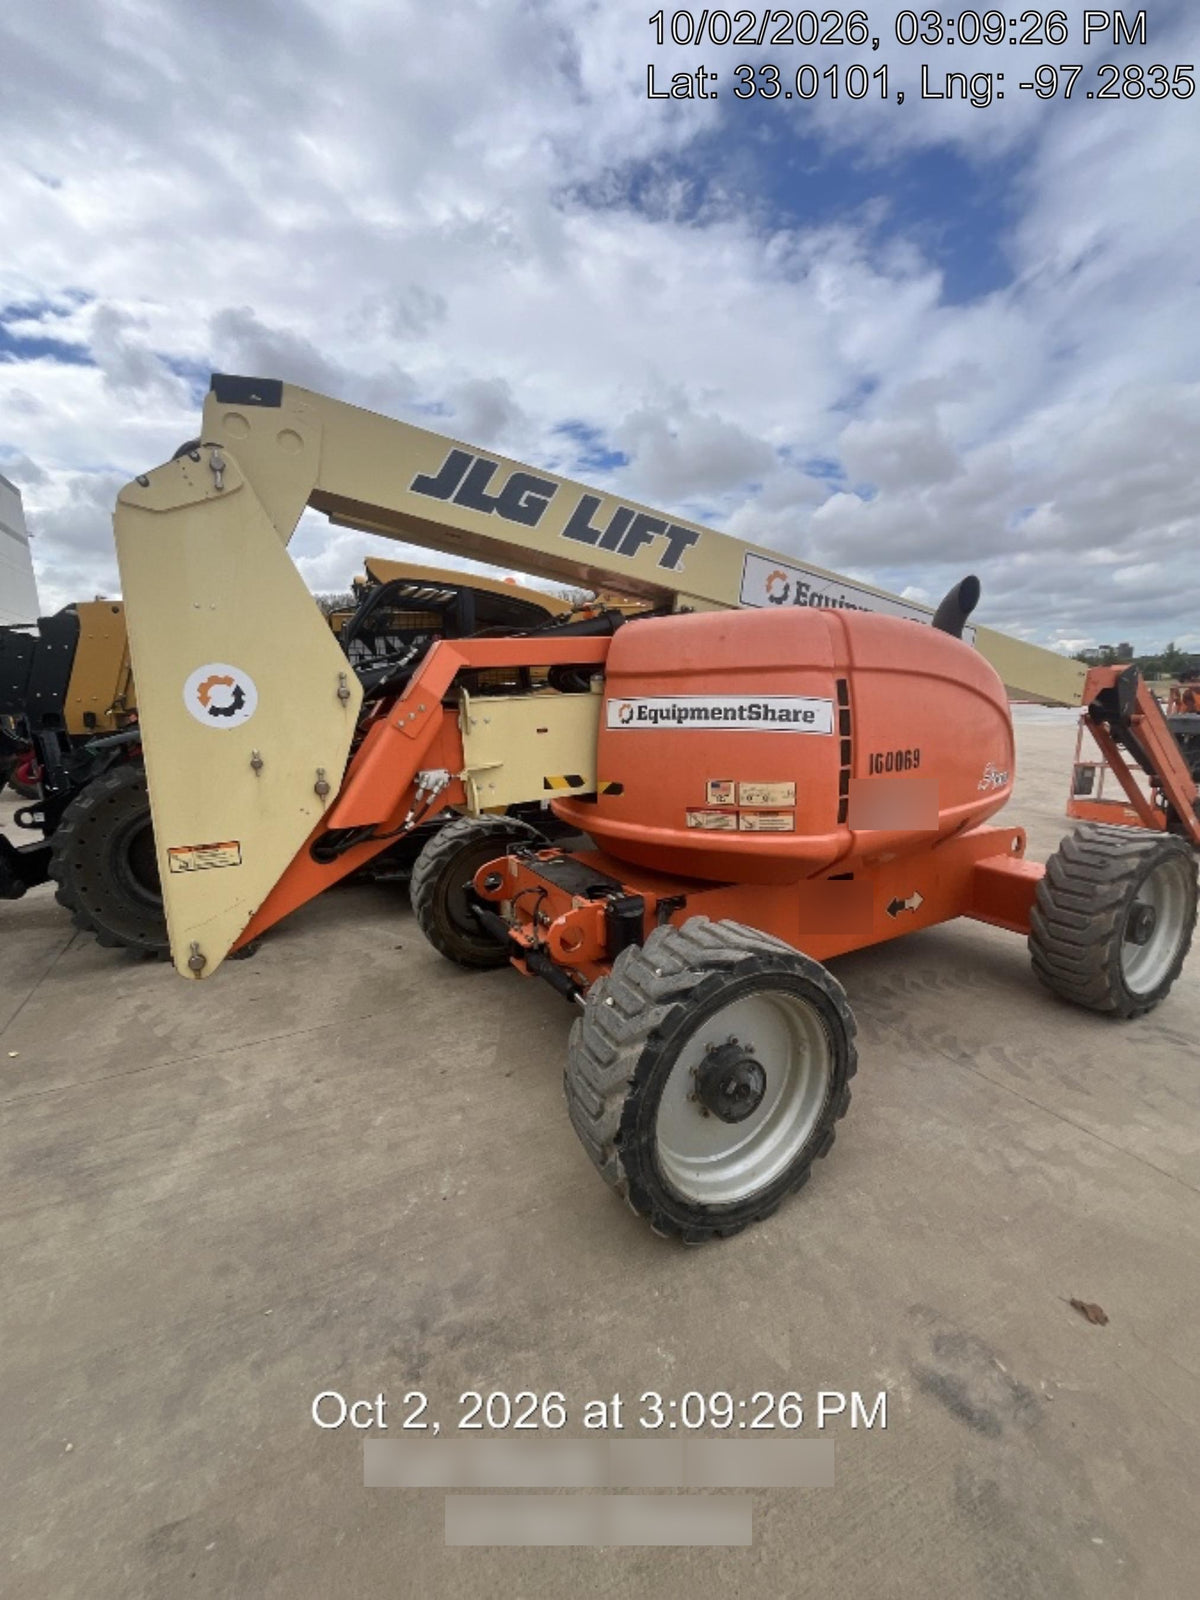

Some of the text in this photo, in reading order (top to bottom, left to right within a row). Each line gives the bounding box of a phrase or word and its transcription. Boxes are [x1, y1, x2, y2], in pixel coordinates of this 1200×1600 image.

[409, 448, 702, 573] JLG LIFT
[636, 703, 815, 724] EquipmentShare
